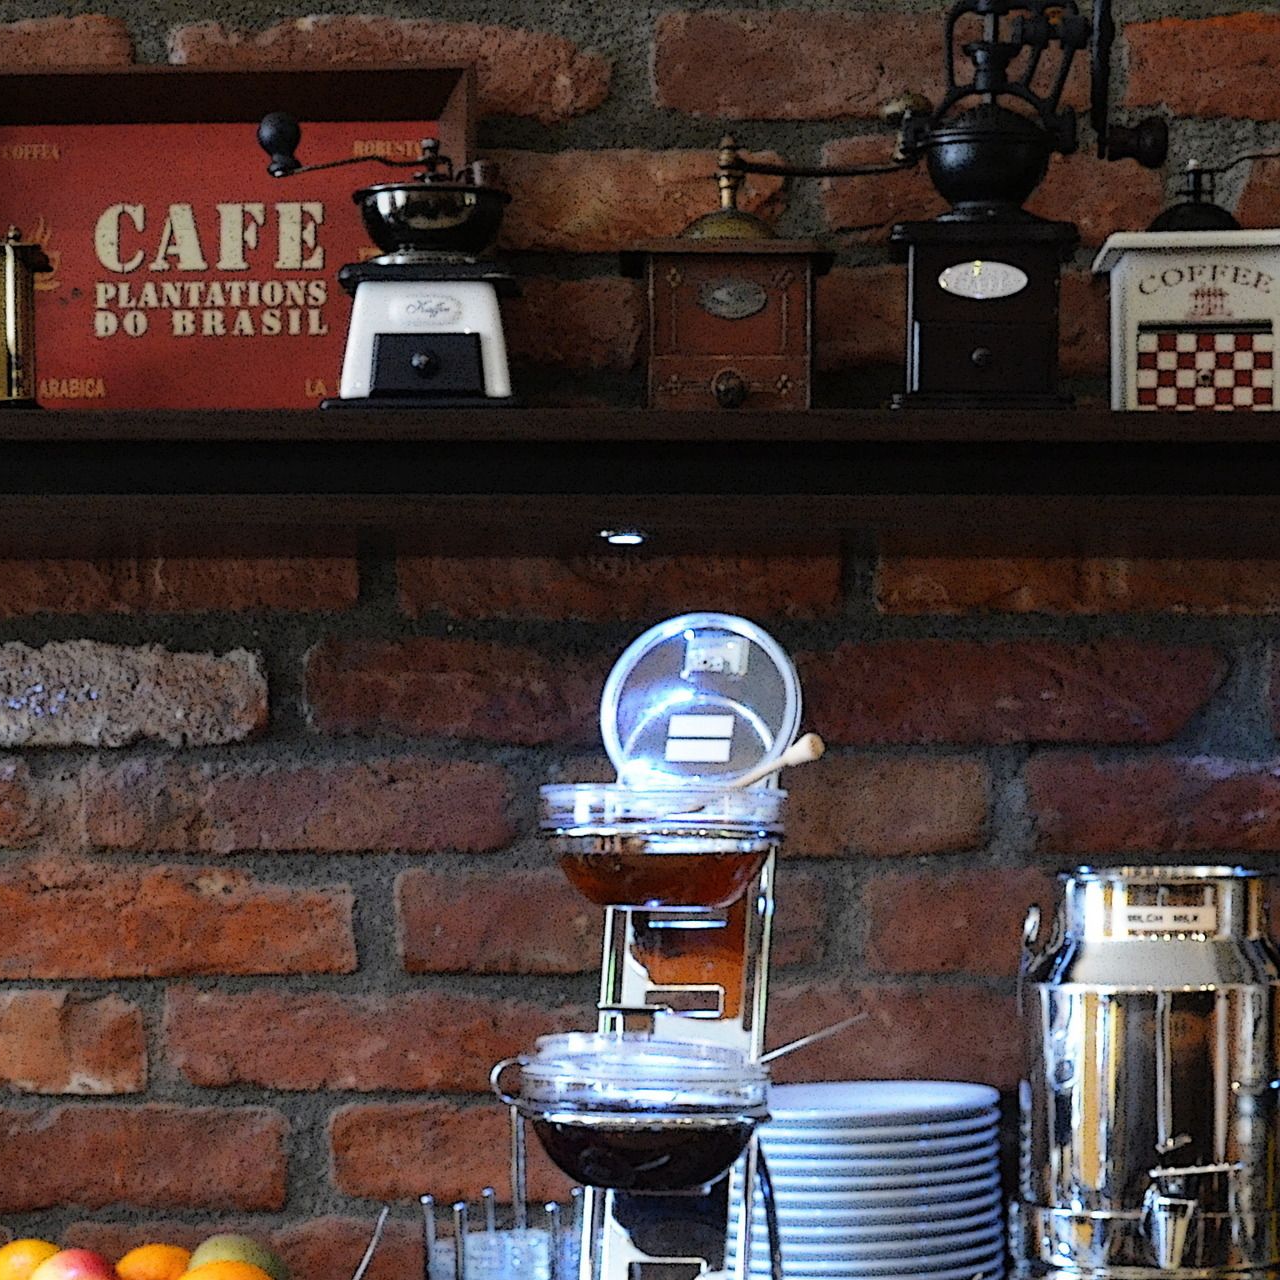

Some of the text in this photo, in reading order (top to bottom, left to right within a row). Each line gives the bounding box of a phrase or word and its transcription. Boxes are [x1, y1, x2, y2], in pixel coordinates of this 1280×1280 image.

[94, 201, 324, 273] CAFE
[1139, 264, 1274, 294] COFFEE
[95, 280, 327, 308] PLANTATIONS
[94, 309, 328, 337] DO BRASIL
[40, 378, 106, 399] ARABICA
